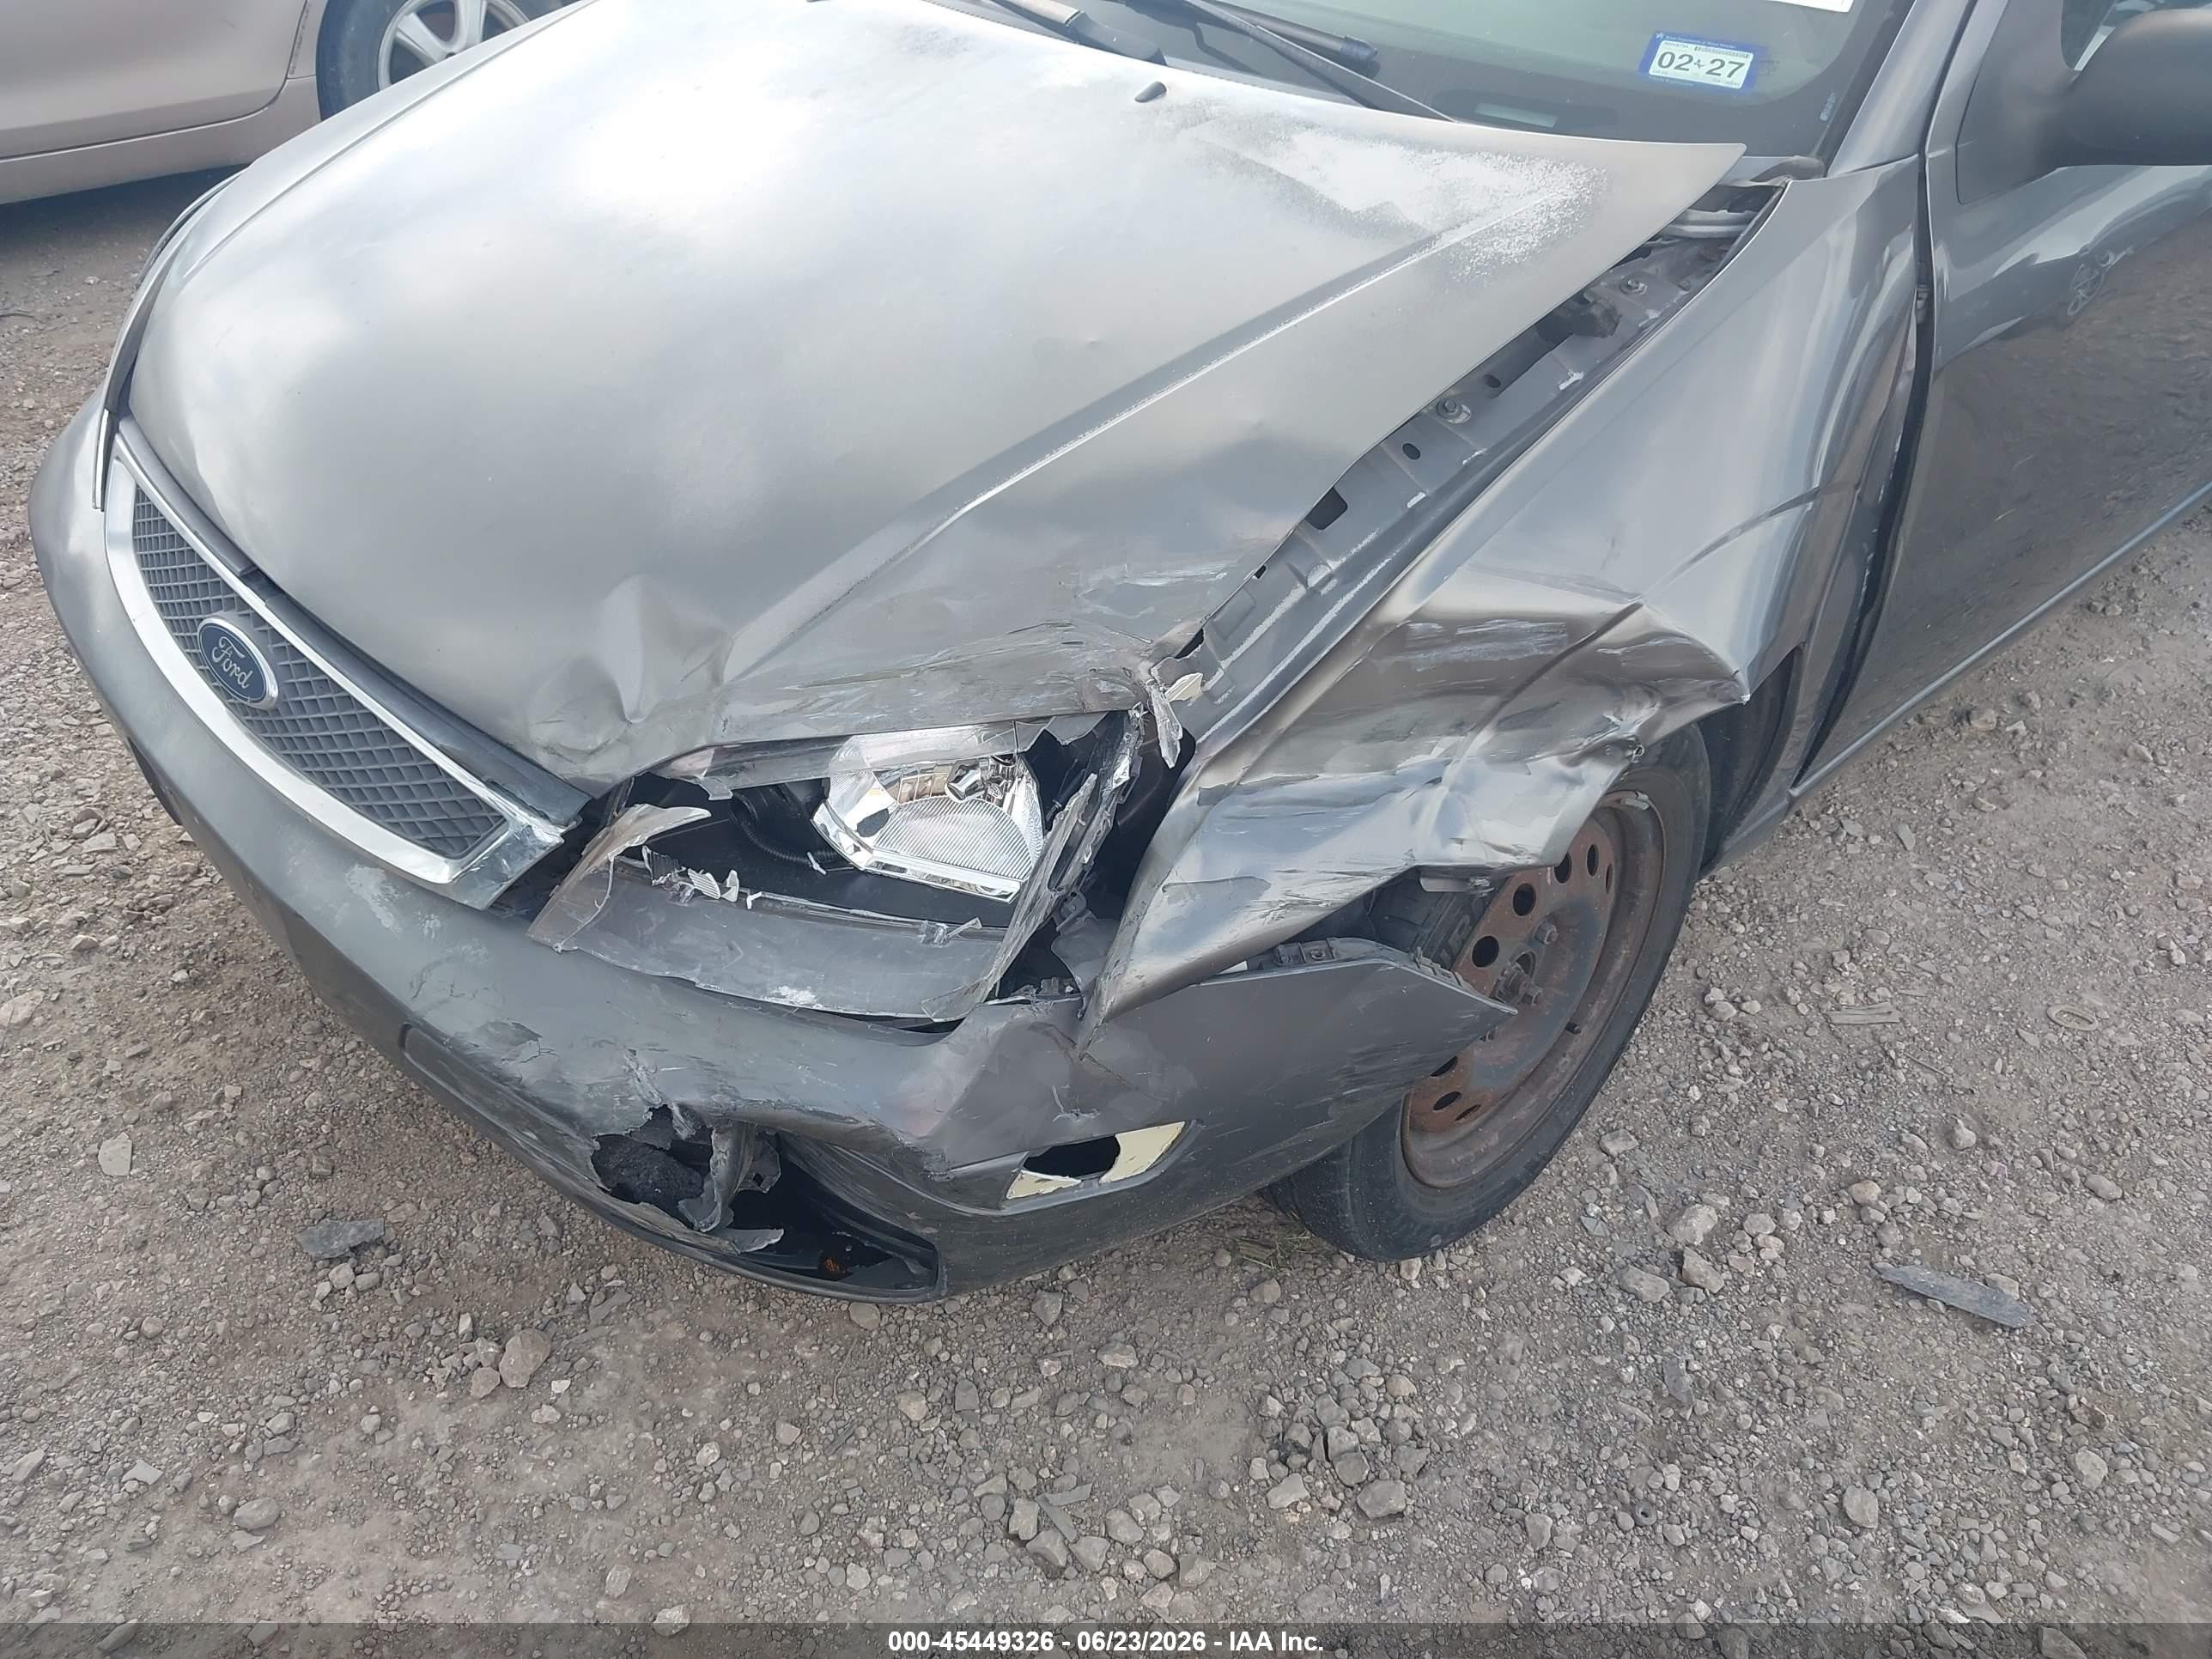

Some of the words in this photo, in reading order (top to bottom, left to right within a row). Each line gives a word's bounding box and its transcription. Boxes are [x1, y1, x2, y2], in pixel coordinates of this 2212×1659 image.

[1657, 51, 1694, 72] 02
[1705, 58, 1746, 79] 27
[211, 636, 253, 689] Ford
